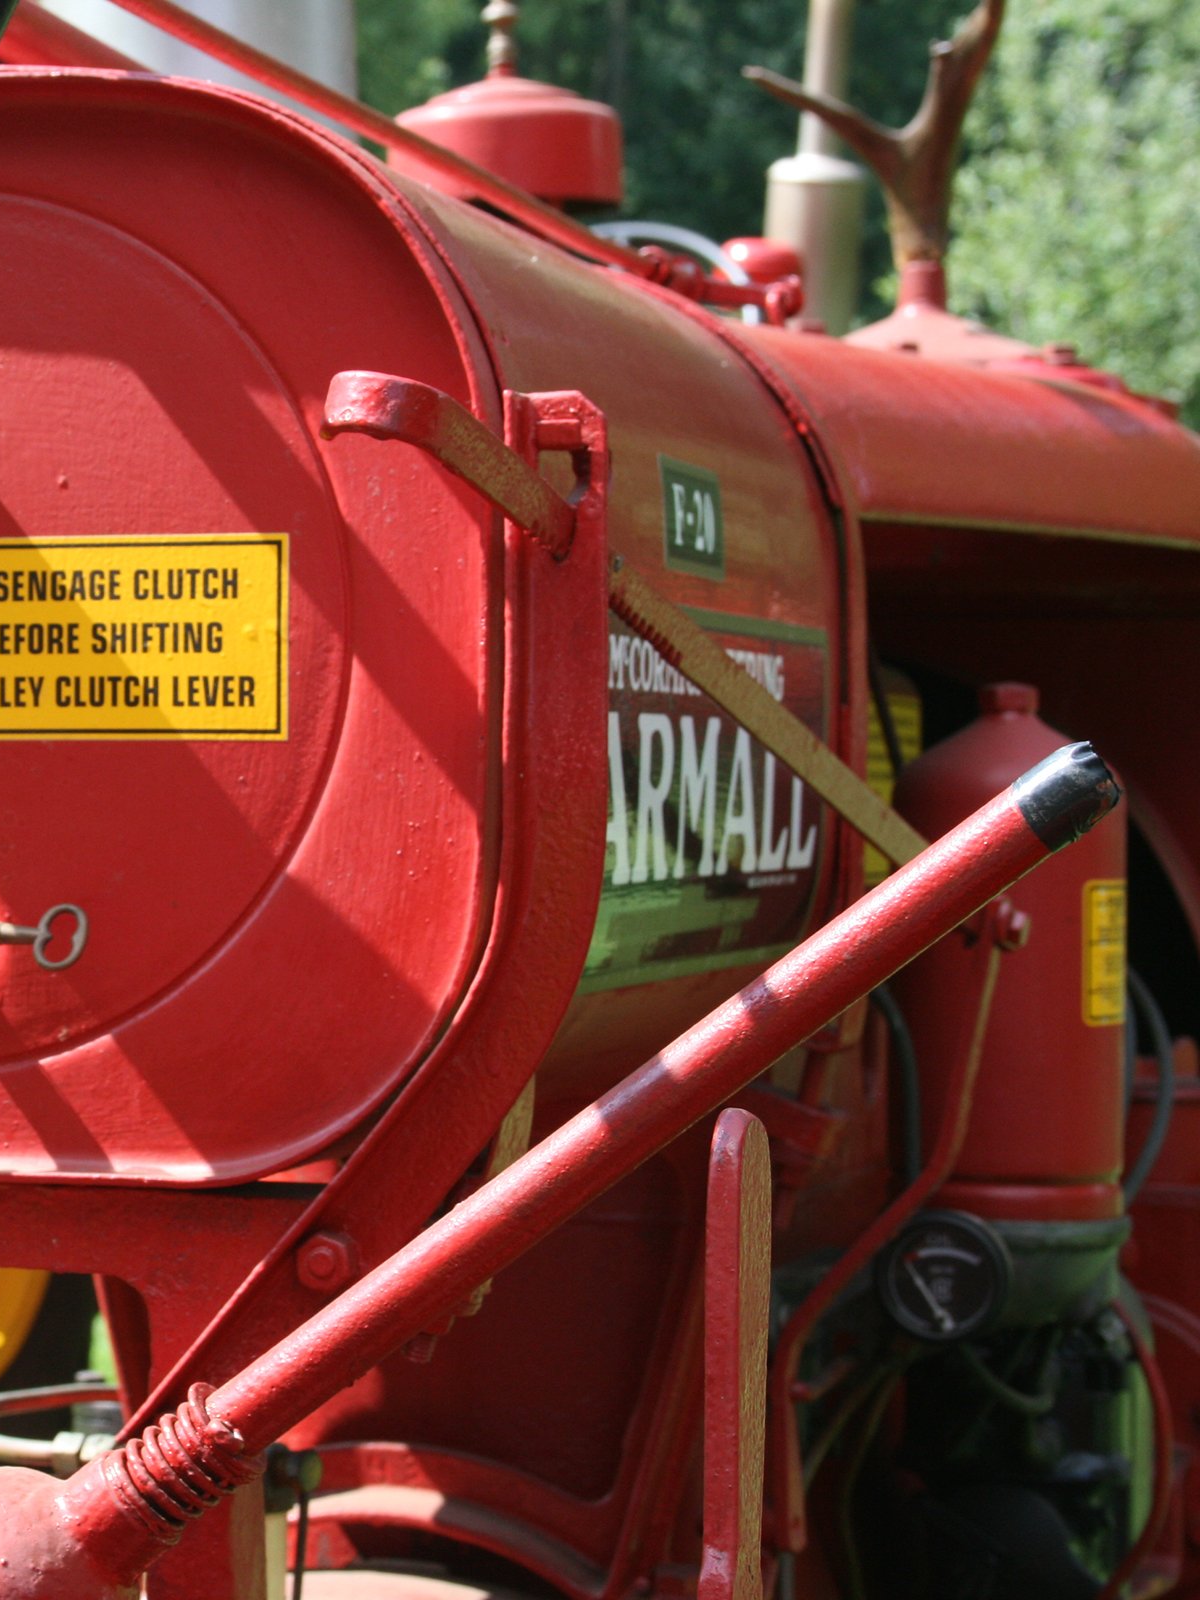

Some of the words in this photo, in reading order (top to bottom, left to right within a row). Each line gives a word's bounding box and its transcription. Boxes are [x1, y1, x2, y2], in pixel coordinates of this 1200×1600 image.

[671, 483, 715, 554] F-20
[133, 568, 239, 600] CLUTCH
[91, 622, 223, 654] SHIFTING
[55, 676, 160, 708] CLUTCH
[172, 675, 256, 708] LEVER
[606, 711, 817, 885] ARMALL
